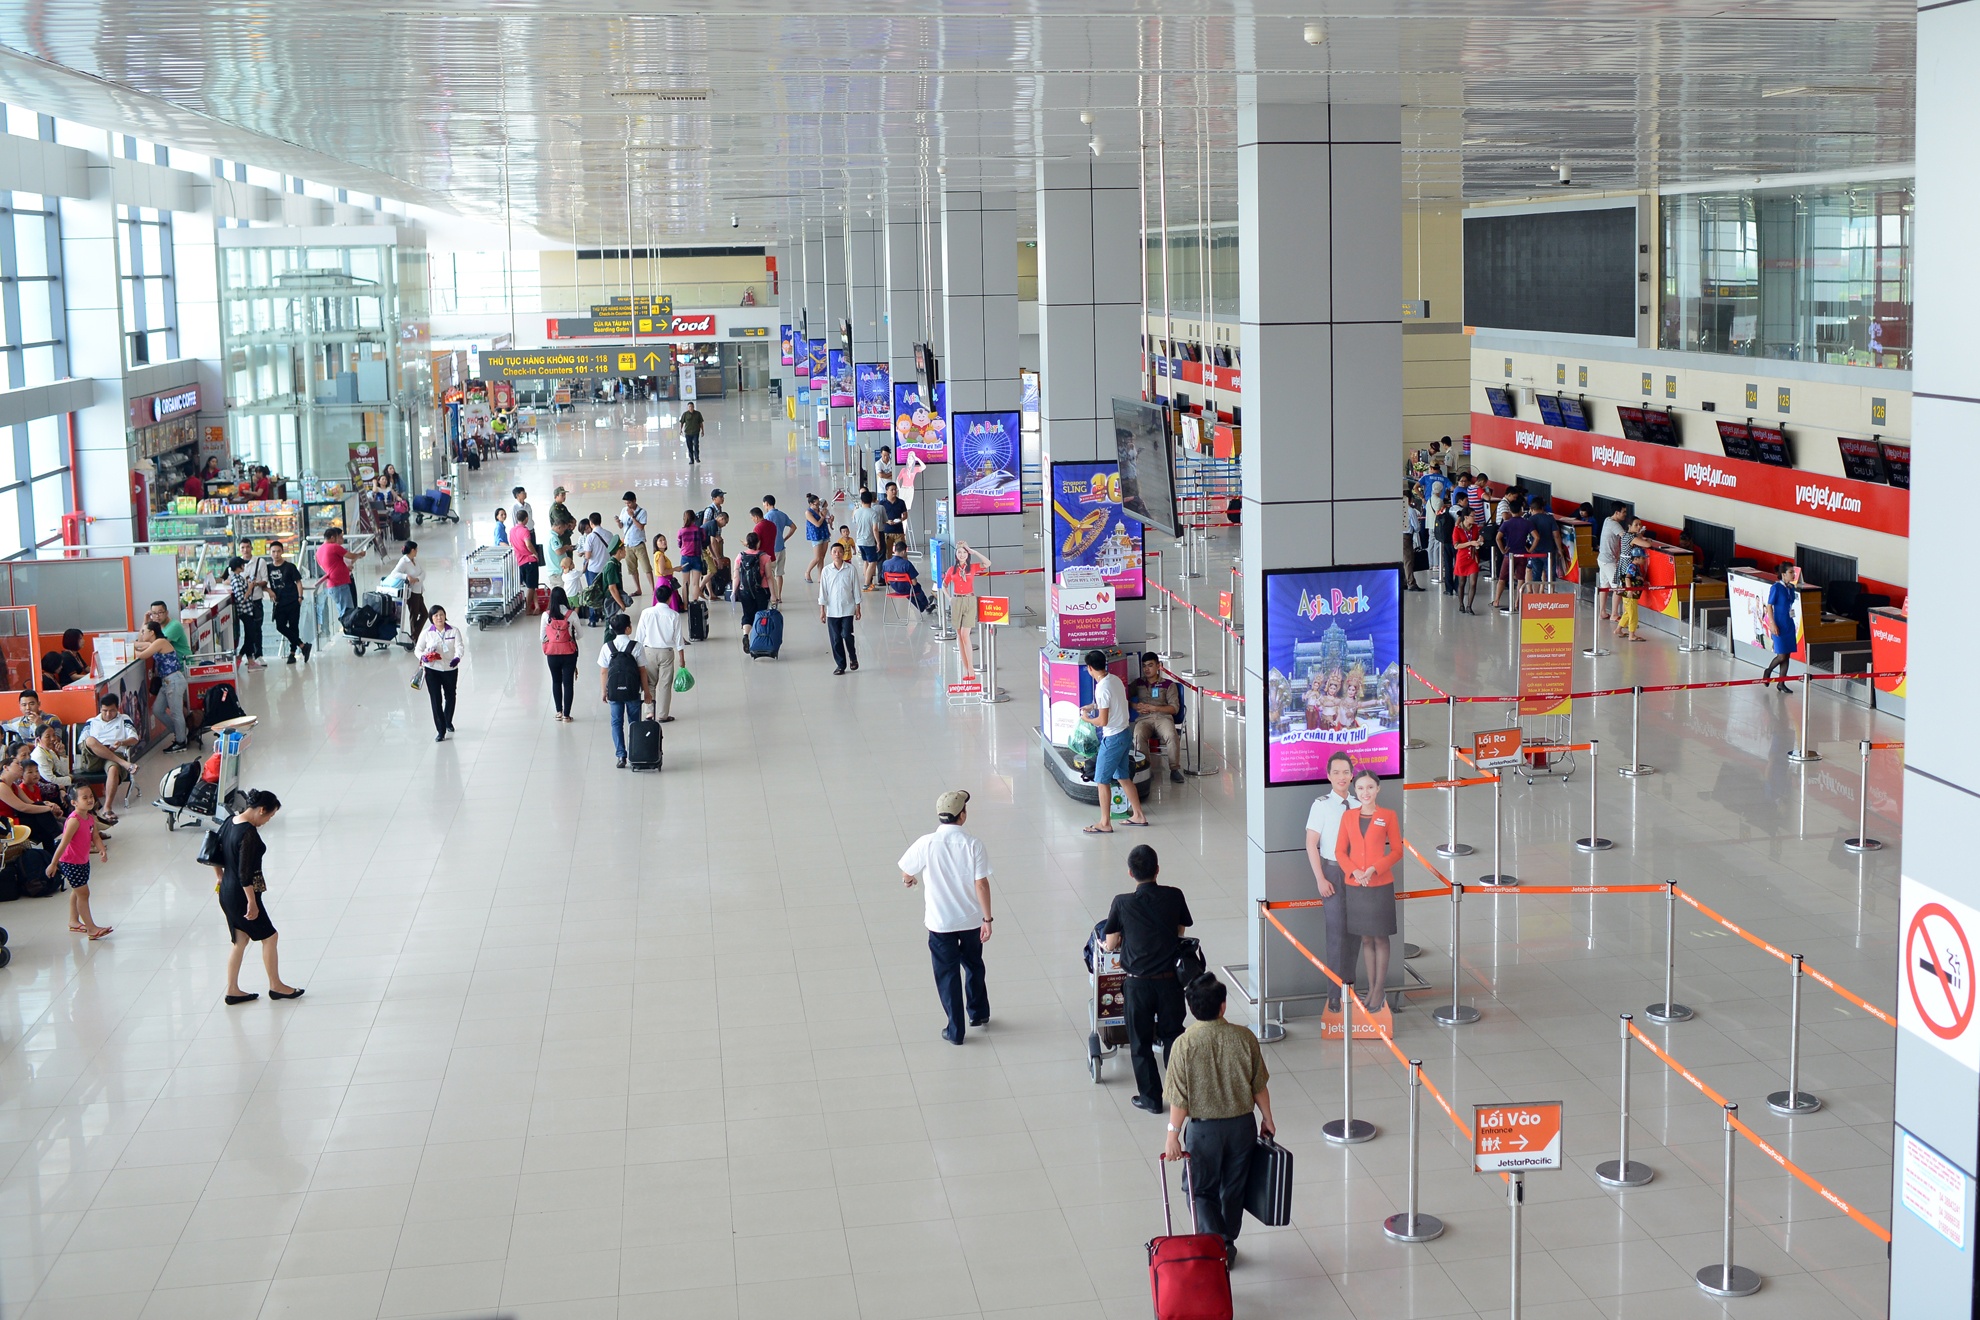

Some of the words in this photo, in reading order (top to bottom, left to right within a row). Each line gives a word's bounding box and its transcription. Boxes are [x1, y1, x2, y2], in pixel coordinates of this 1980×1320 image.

[488, 356, 503, 365] THỦ
[506, 357, 521, 367] TỤC
[523, 354, 545, 365] HÀNG
[546, 353, 575, 364] KHÔNG
[595, 355, 608, 363] 118
[503, 367, 536, 376] Check-in
[538, 366, 573, 375] Counters
[595, 365, 608, 373] 118
[1579, 372, 1587, 382] 121
[1642, 379, 1651, 390] 122
[1666, 381, 1676, 393] 123
[1746, 391, 1757, 402] 124
[1778, 394, 1790, 406] 125
[162, 394, 182, 414] ORGANIC
[182, 391, 197, 408] COFFEE
[1873, 405, 1885, 418] 126
[969, 420, 985, 436] Asia
[985, 419, 1004, 433] Park
[1854, 467, 1865, 475] CHU
[1062, 480, 1087, 488] Singapore
[1066, 603, 1097, 611] NASCO
[1297, 588, 1332, 621] Asia
[1331, 584, 1370, 616] Park
[1283, 733, 1301, 742] MỘT
[1304, 729, 1326, 740] CHÂU
[1336, 729, 1347, 742] KỲ
[1351, 726, 1366, 742] THÚ
[1479, 734, 1491, 744] Lối
[1481, 1110, 1503, 1128] Lối
[1507, 1110, 1541, 1126] Vào
[1498, 1158, 1552, 1167] JetstarPacific
